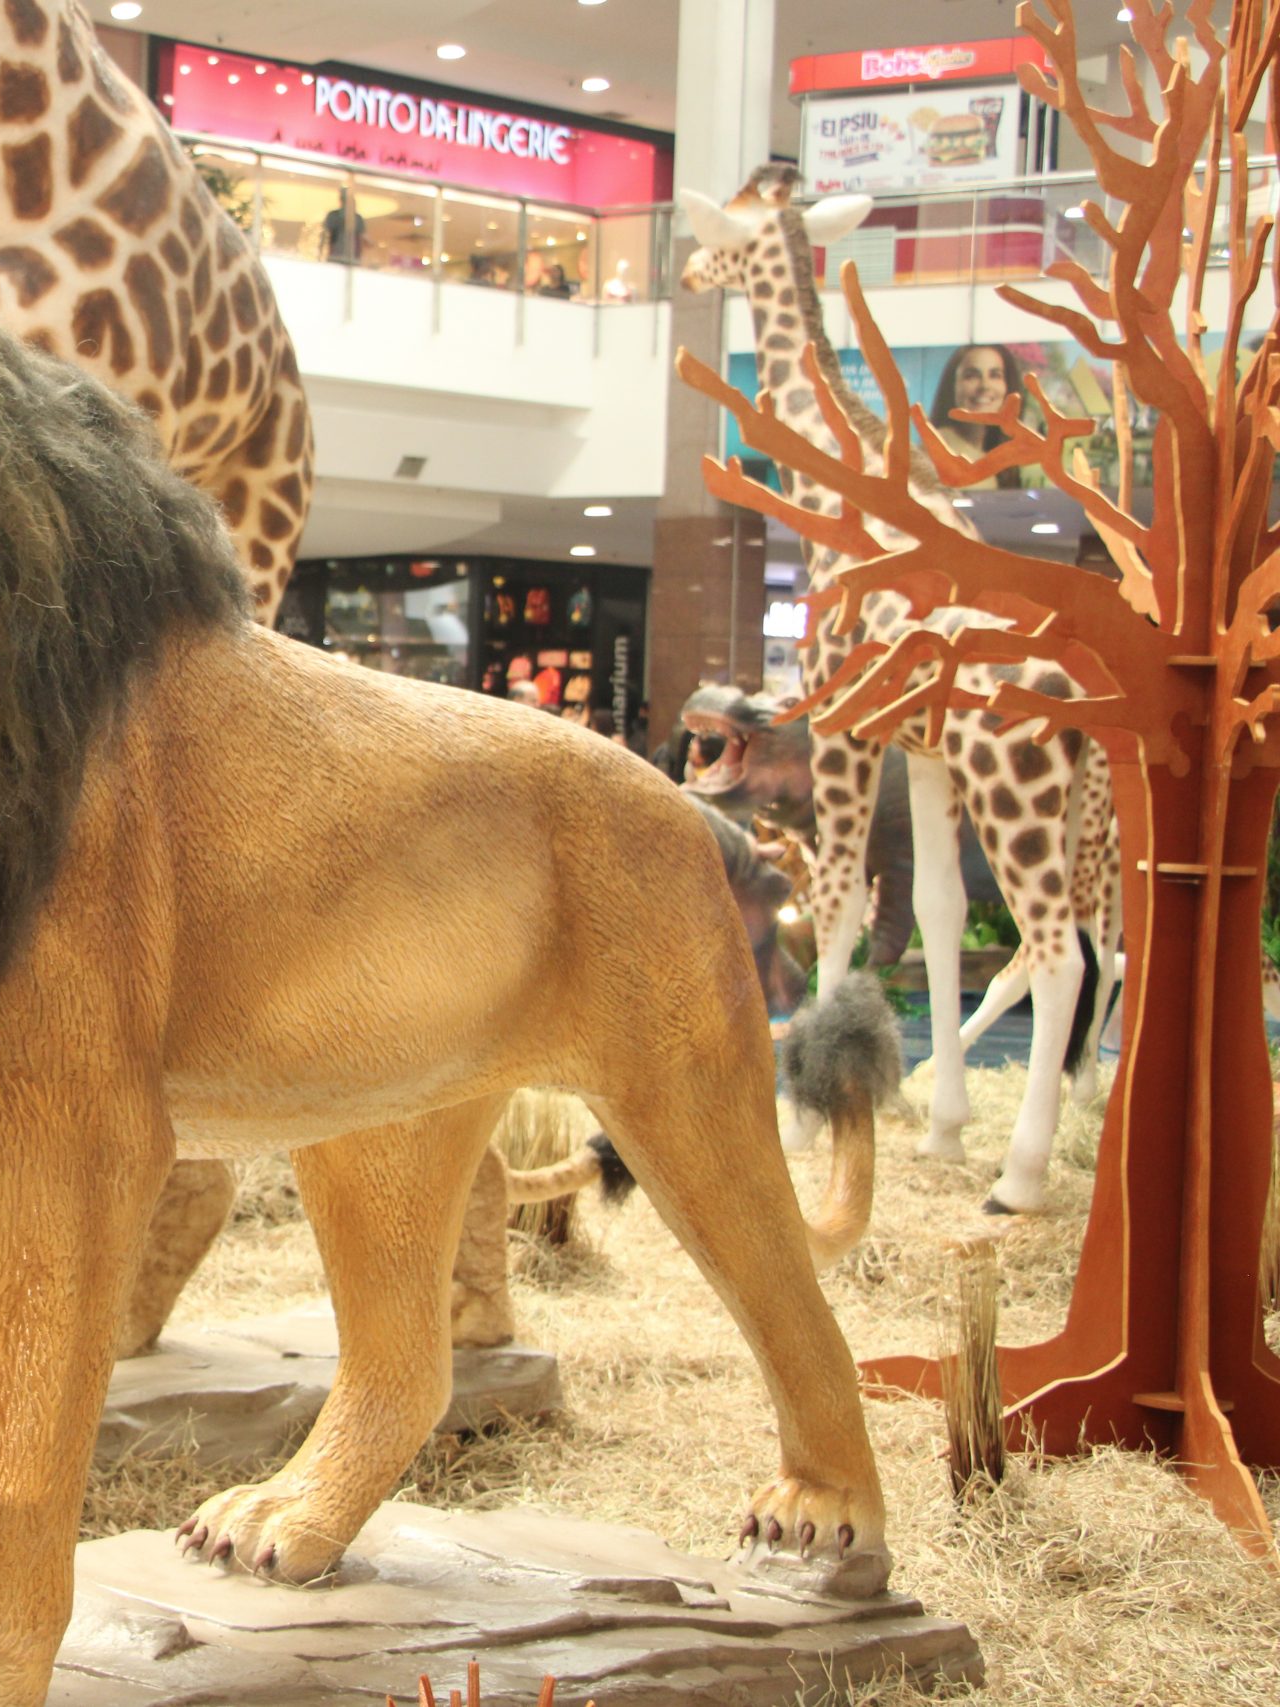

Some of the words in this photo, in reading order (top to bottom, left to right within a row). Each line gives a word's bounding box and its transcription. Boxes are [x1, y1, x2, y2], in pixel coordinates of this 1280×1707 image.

[315, 76, 416, 133] PONTO
[419, 100, 454, 143] DA
[455, 109, 570, 164] LINGERIE
[839, 112, 878, 136] PSIU
